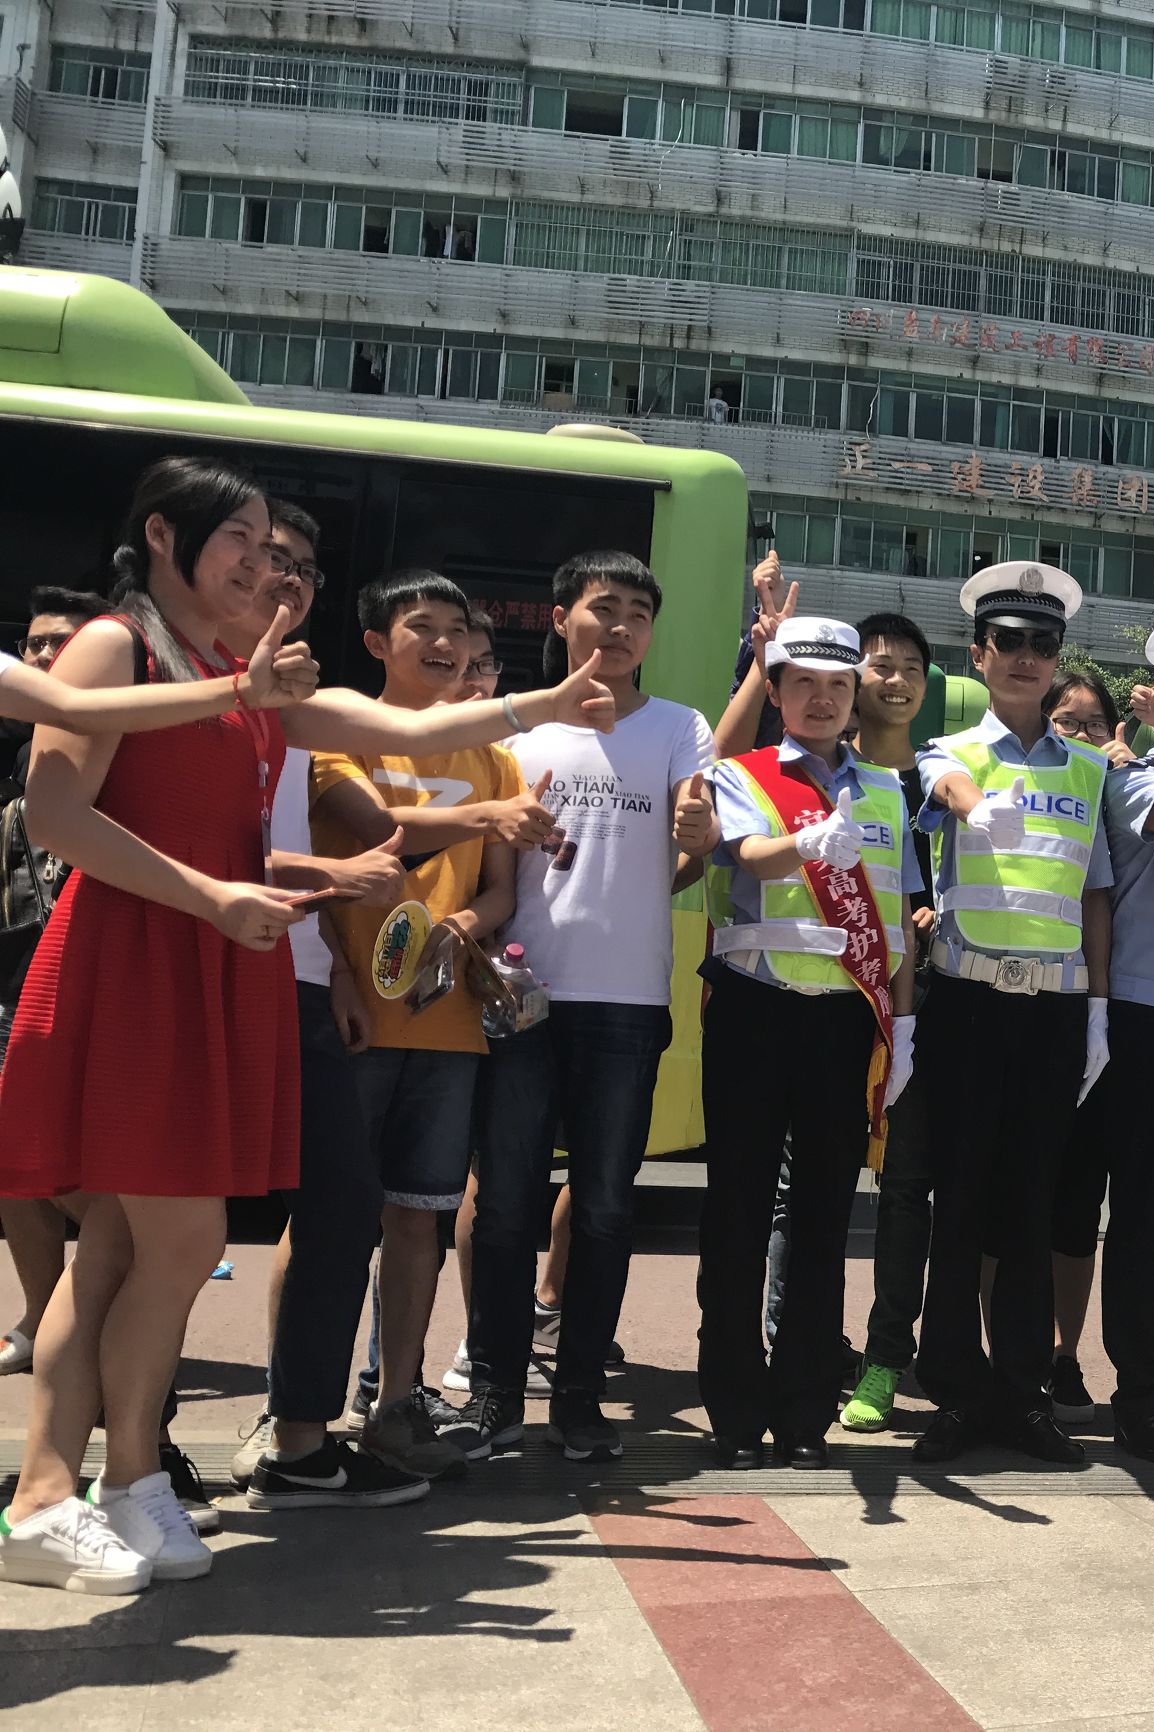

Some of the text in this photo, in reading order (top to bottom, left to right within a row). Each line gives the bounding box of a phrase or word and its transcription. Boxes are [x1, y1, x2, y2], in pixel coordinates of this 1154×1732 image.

[838, 442, 1148, 514] 正一建设集团
[572, 780, 615, 794] TIAN
[560, 795, 652, 813] XIAO TIAN
